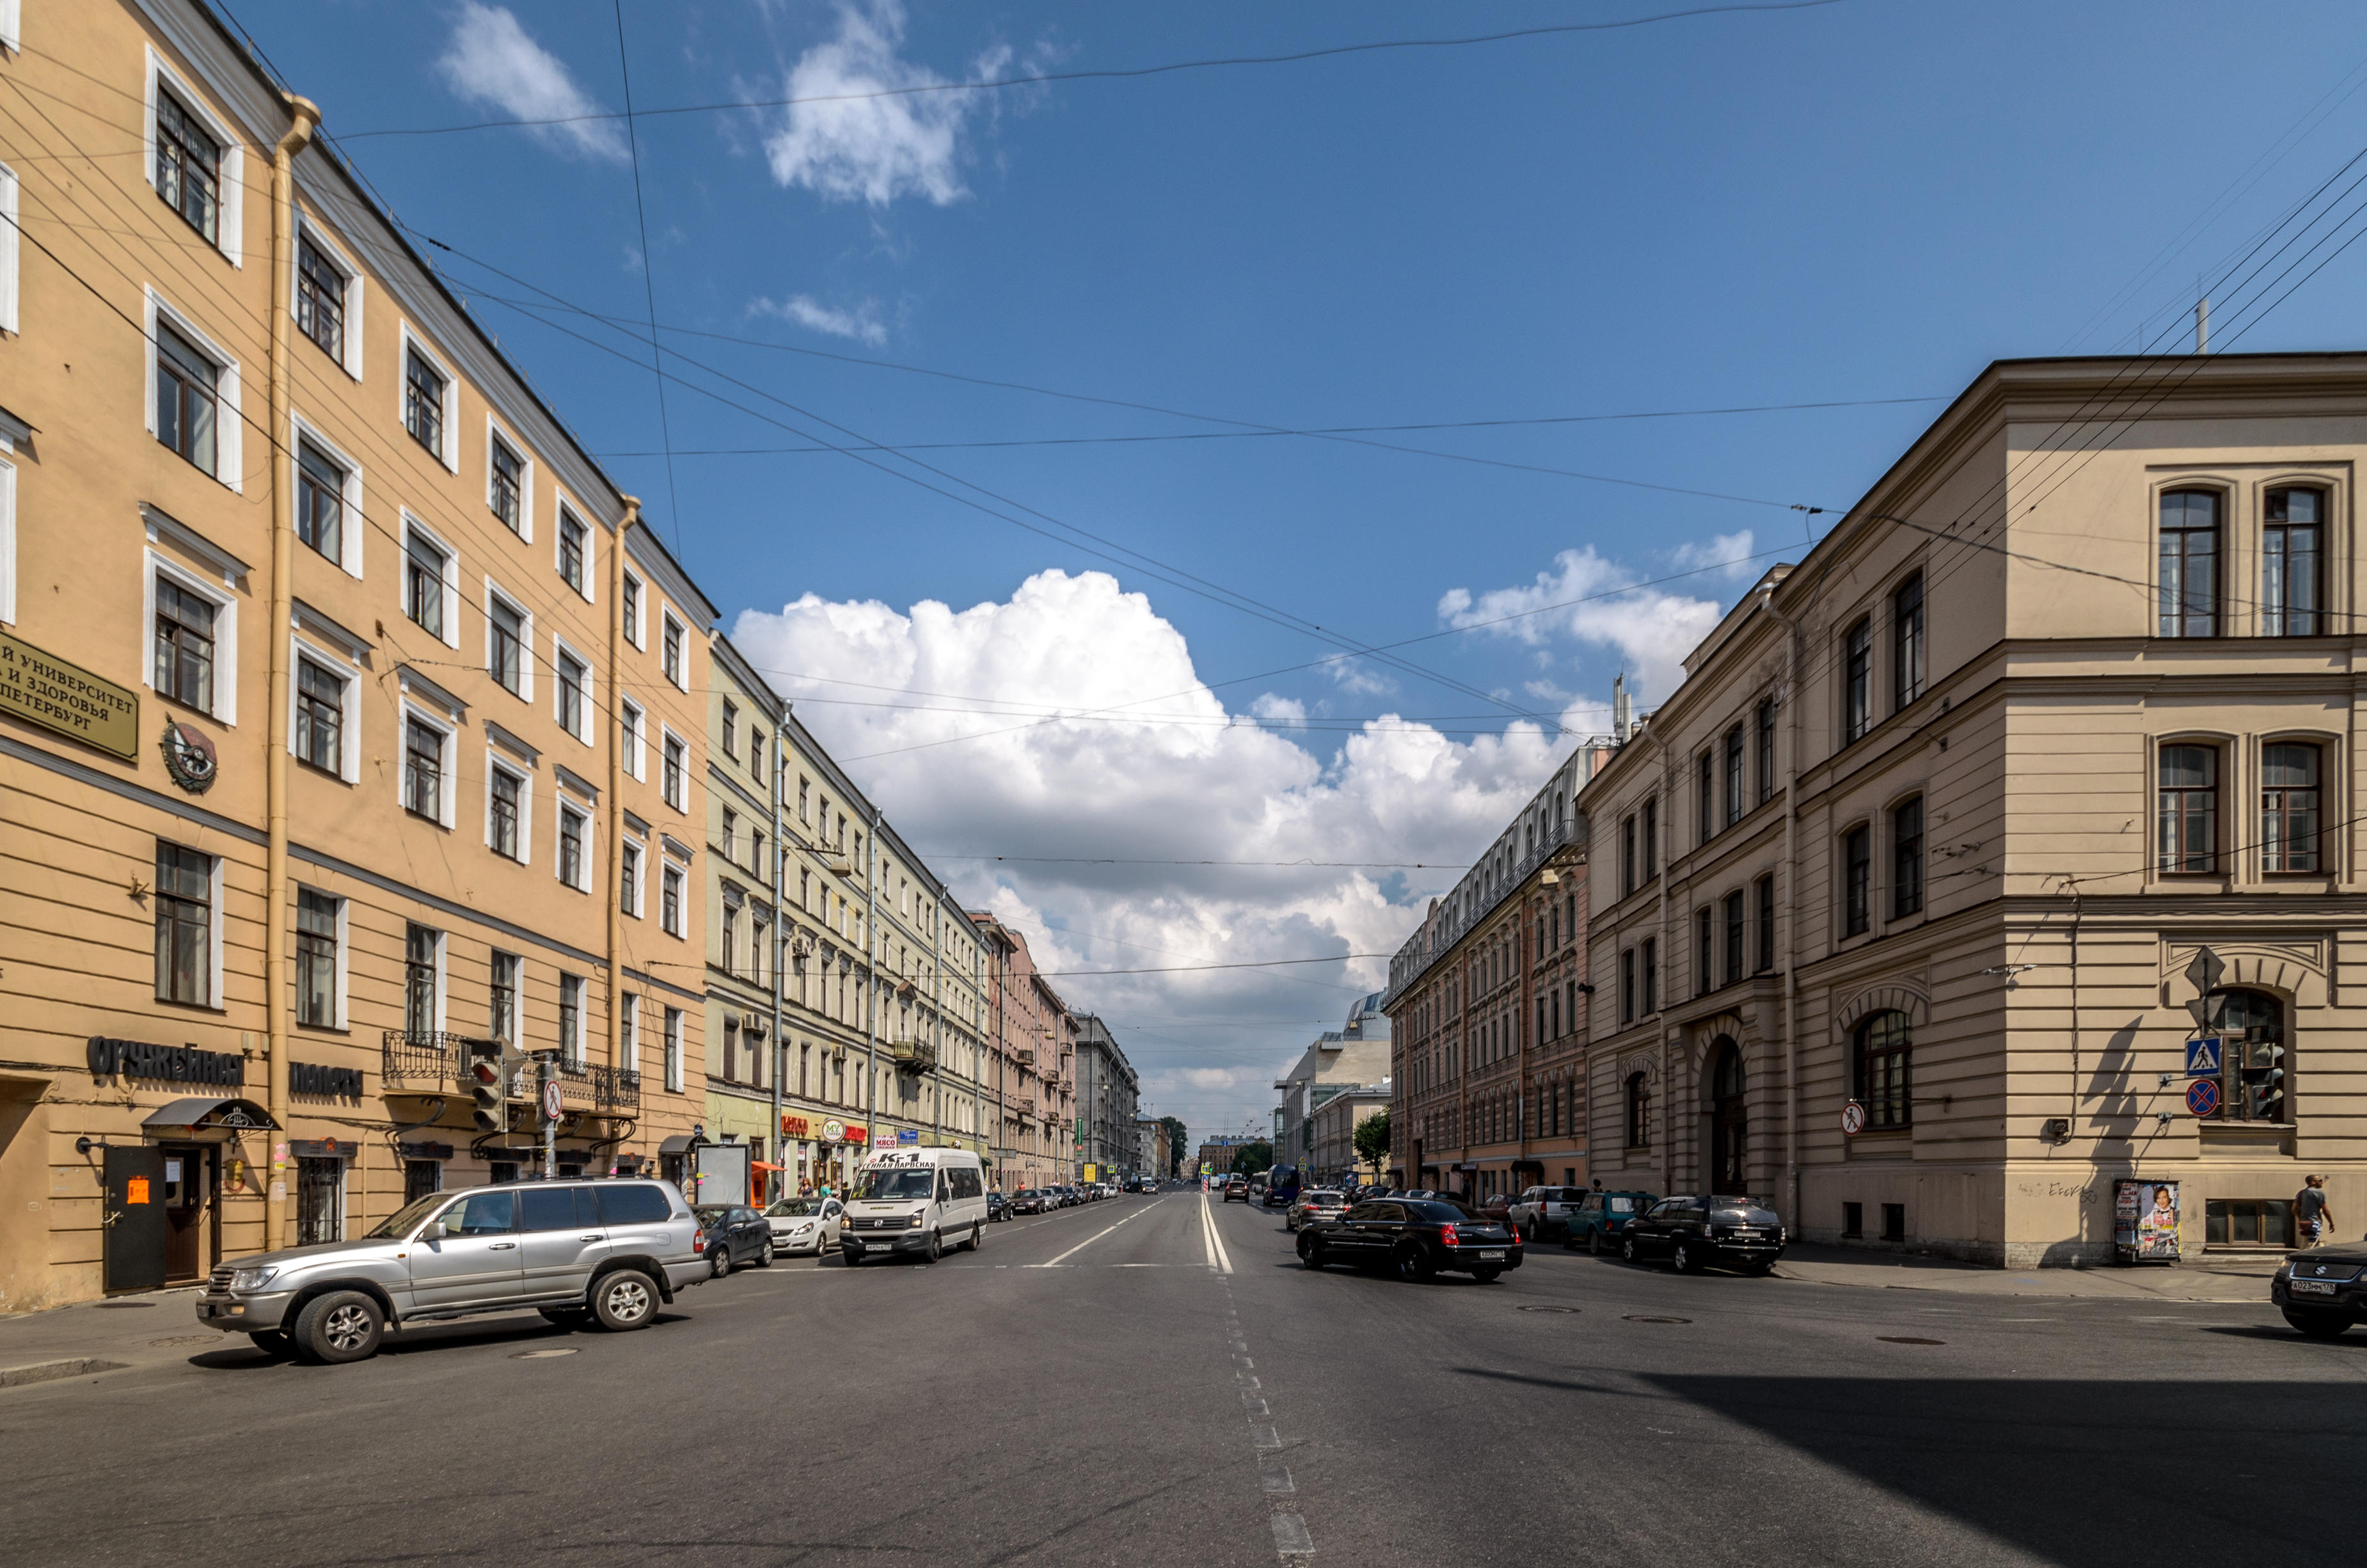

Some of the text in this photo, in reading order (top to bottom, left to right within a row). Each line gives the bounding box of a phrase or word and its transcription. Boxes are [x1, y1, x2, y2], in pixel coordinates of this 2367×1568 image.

[0, 682, 91, 731] ПЕТЕРБУРГ
[8, 667, 109, 722] И ЗДОРОВЬЯ
[20, 654, 132, 714] УНИВЕРСИТЕТ
[87, 1035, 244, 1086] ОРУЖЕЙНАЯ
[895, 1161, 935, 1169] НАРВСКАЯ
